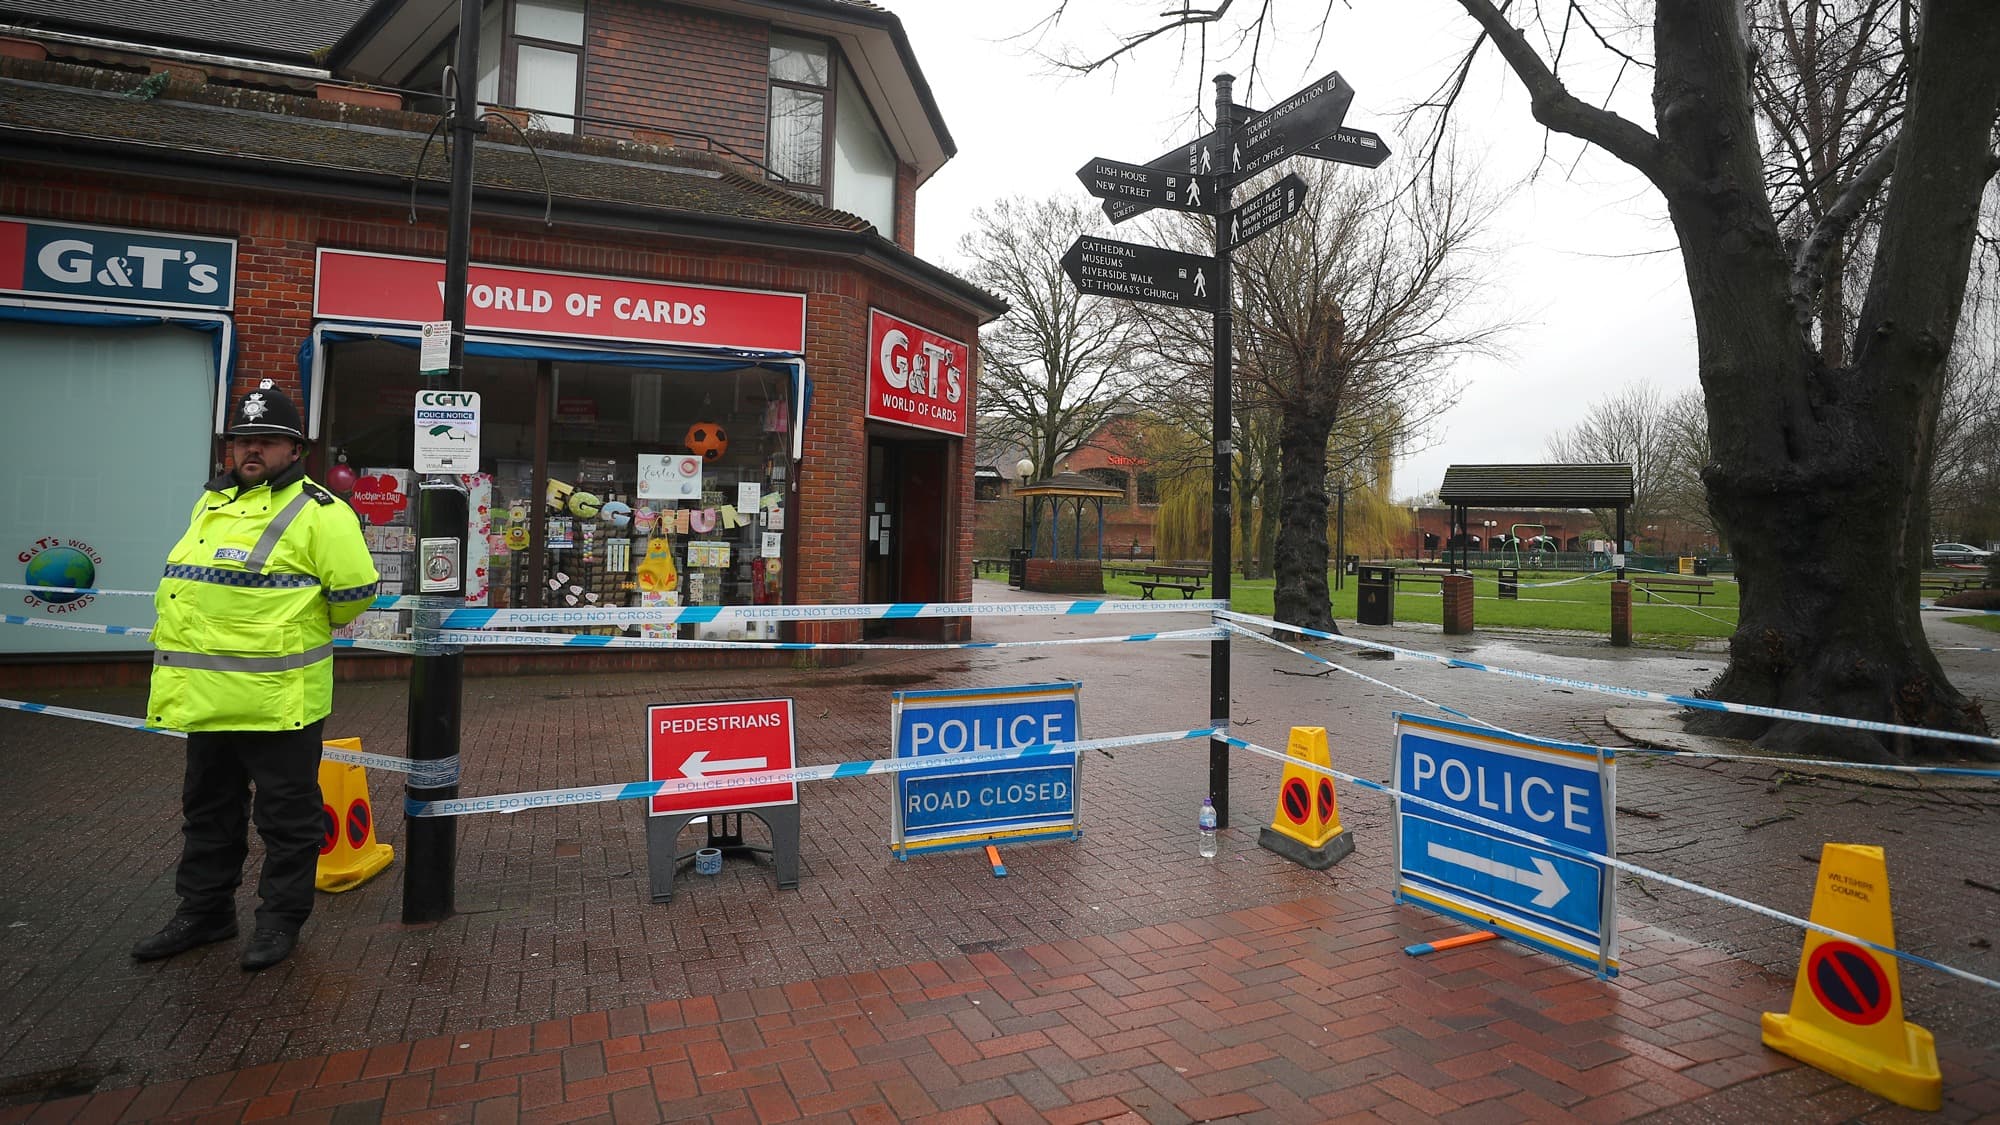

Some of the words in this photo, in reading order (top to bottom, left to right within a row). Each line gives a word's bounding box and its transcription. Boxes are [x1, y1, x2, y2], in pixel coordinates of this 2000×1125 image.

[1247, 115, 1273, 136] TOURIST
[1274, 84, 1324, 120] INFORMATION
[1246, 127, 1272, 149] LIBRARY
[1338, 134, 1357, 144] PARK
[1246, 158, 1261, 172] POST
[1262, 145, 1285, 163] OFFICE
[1096, 165, 1117, 177] LUSH
[1120, 170, 1148, 183] HOUSE
[1096, 180, 1116, 191] NEW
[1119, 184, 1151, 198] STREET
[1242, 196, 1263, 217] MARKET
[1262, 197, 1282, 216] STREET
[1262, 208, 1282, 227] STREET
[1081, 241, 1136, 258] CATHEDRAL
[37, 239, 219, 294] G&T's
[1081, 253, 1123, 268] MUSEUMS
[1081, 265, 1128, 281] RIVERSIDE
[1130, 272, 1154, 285] WALK
[1095, 280, 1140, 295] THOMAS'S
[1143, 288, 1179, 301] CHURCH
[564, 293, 601, 318] OF
[613, 298, 706, 327] CARDS
[880, 328, 962, 404] G&T's
[422, 392, 473, 407] CCTV
[882, 393, 915, 413] WORLD
[918, 401, 929, 416] OF
[931, 405, 957, 423] CARDS
[354, 491, 386, 502] Mother's
[386, 491, 401, 503] Day
[68, 539, 102, 564] WORLD
[24, 595, 43, 608] OF
[47, 594, 95, 614] CARDS
[735, 608, 777, 618] POLICE
[782, 608, 800, 617] DO
[803, 608, 828, 617] NOT
[831, 607, 871, 616] CROSS
[935, 605, 975, 614] POLICE
[510, 613, 559, 623] POLICE
[563, 612, 583, 622] DO
[587, 612, 614, 621] NOT
[617, 611, 663, 620] CROSS
[449, 633, 469, 642] DO
[473, 634, 500, 643] NOT
[505, 635, 550, 644] CROSS
[649, 631, 677, 639] Easter
[659, 713, 782, 735] PEDESTRIANS
[911, 713, 1064, 757] POLICE
[376, 758, 398, 768] NOT
[883, 760, 922, 770] POLICE
[677, 779, 724, 792] POLICE
[726, 777, 746, 787] DO
[749, 775, 773, 785] NOT
[778, 770, 819, 781] CROSS
[444, 800, 495, 813] POLICE
[499, 798, 519, 809] DO
[523, 795, 550, 806] NOT
[556, 791, 602, 804] CROSS
[908, 790, 971, 813] ROAD
[979, 782, 1067, 806] CLOSED
[1412, 751, 1592, 835] POLICE
[1828, 872, 1875, 891] WILTSHIRE
[1830, 884, 1871, 902] COUNCIL
